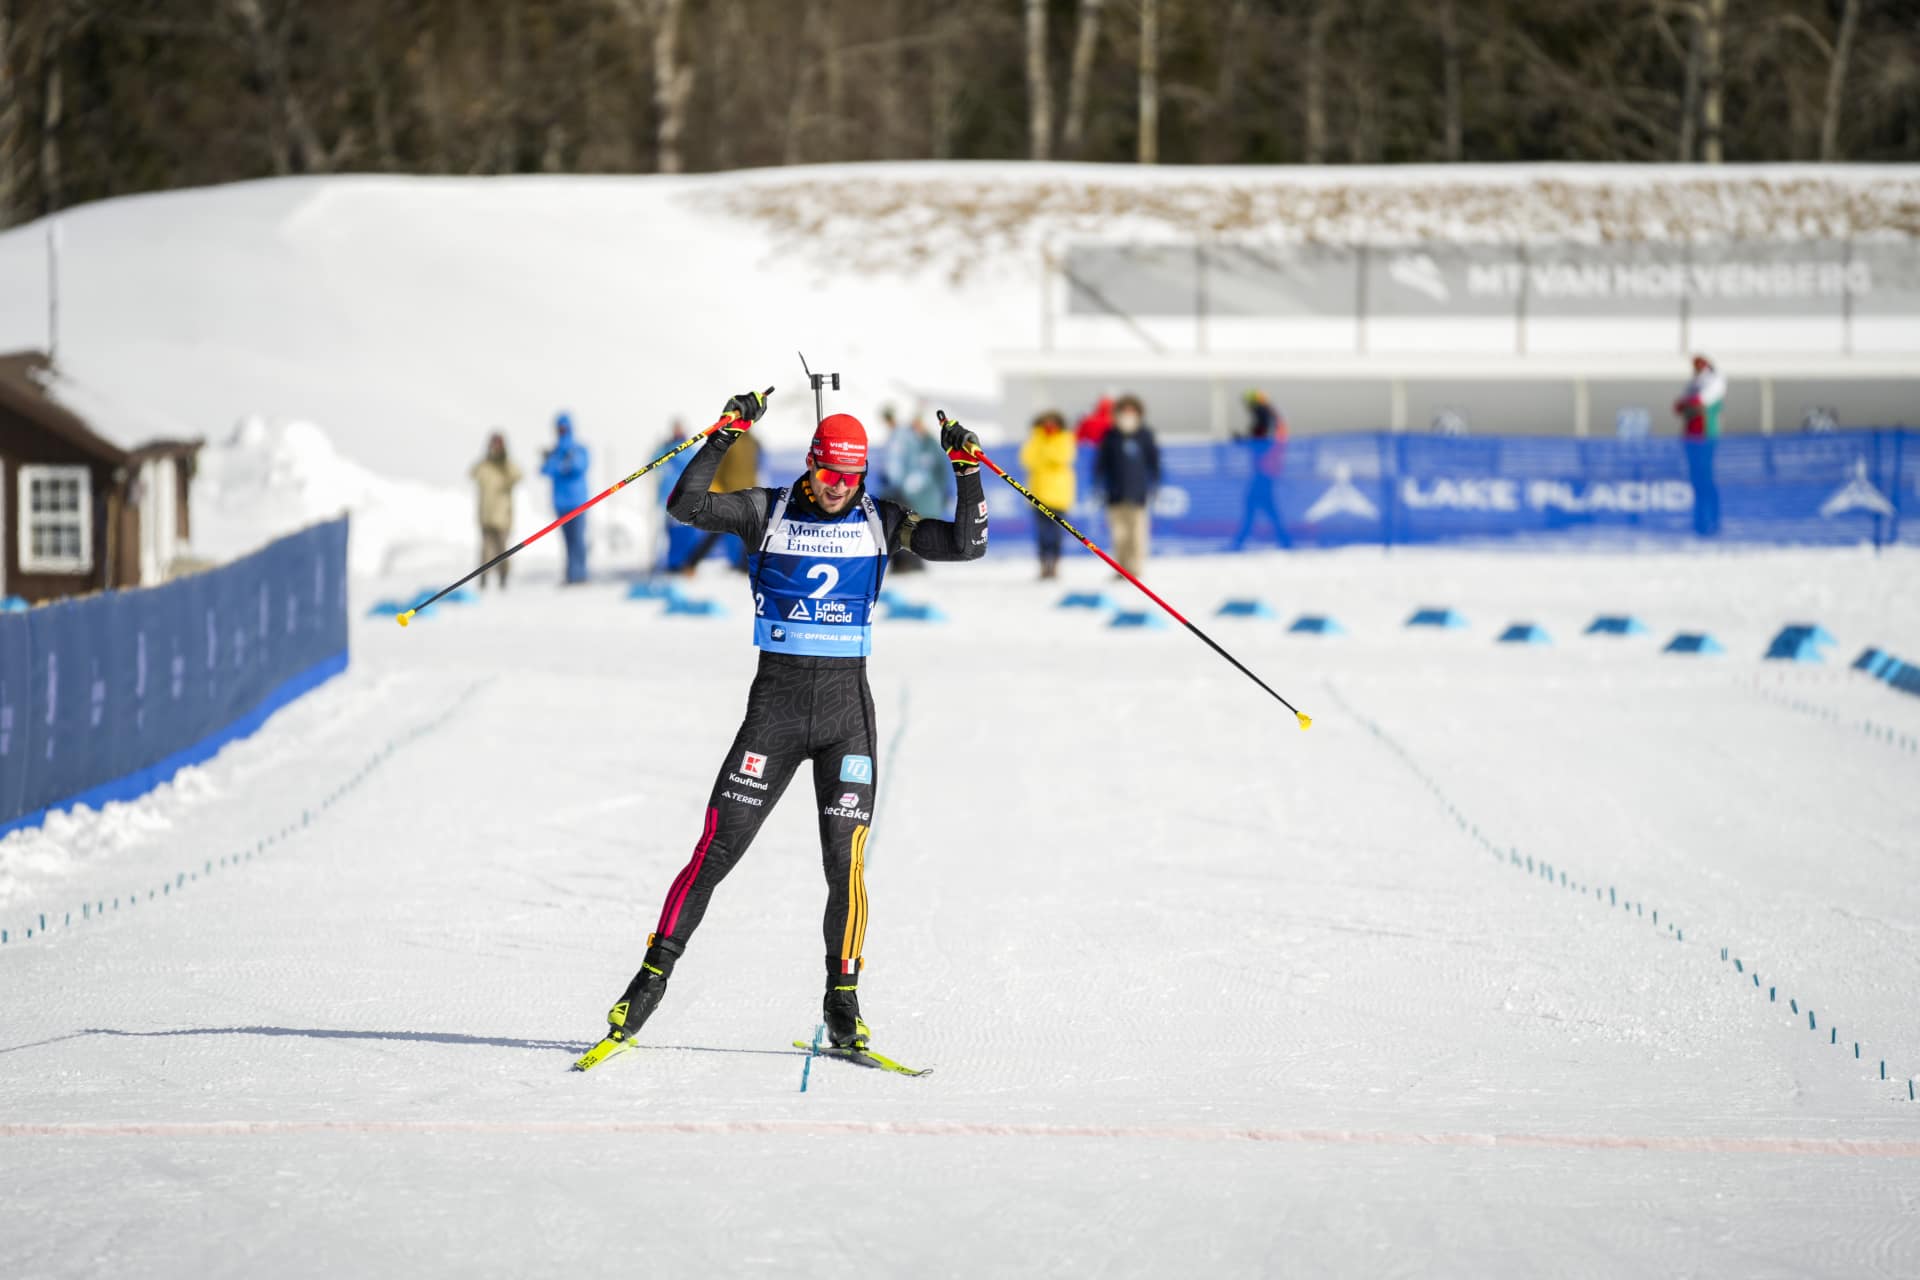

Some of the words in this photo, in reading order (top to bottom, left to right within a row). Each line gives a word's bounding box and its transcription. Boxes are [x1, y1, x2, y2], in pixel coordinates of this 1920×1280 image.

[1530, 263, 1612, 297] VAN
[1401, 478, 1519, 510] LAKE
[1526, 480, 1696, 513] PLACID
[787, 523, 862, 538] Montefiore
[786, 538, 843, 554] Einstein
[806, 563, 840, 599] 2
[756, 592, 765, 616] 2
[815, 600, 846, 612] Lake
[815, 611, 853, 623] Placid
[790, 631, 804, 639] THE
[728, 772, 769, 791] Kaufland
[732, 792, 764, 807] TERREX
[824, 806, 870, 821] tectake
